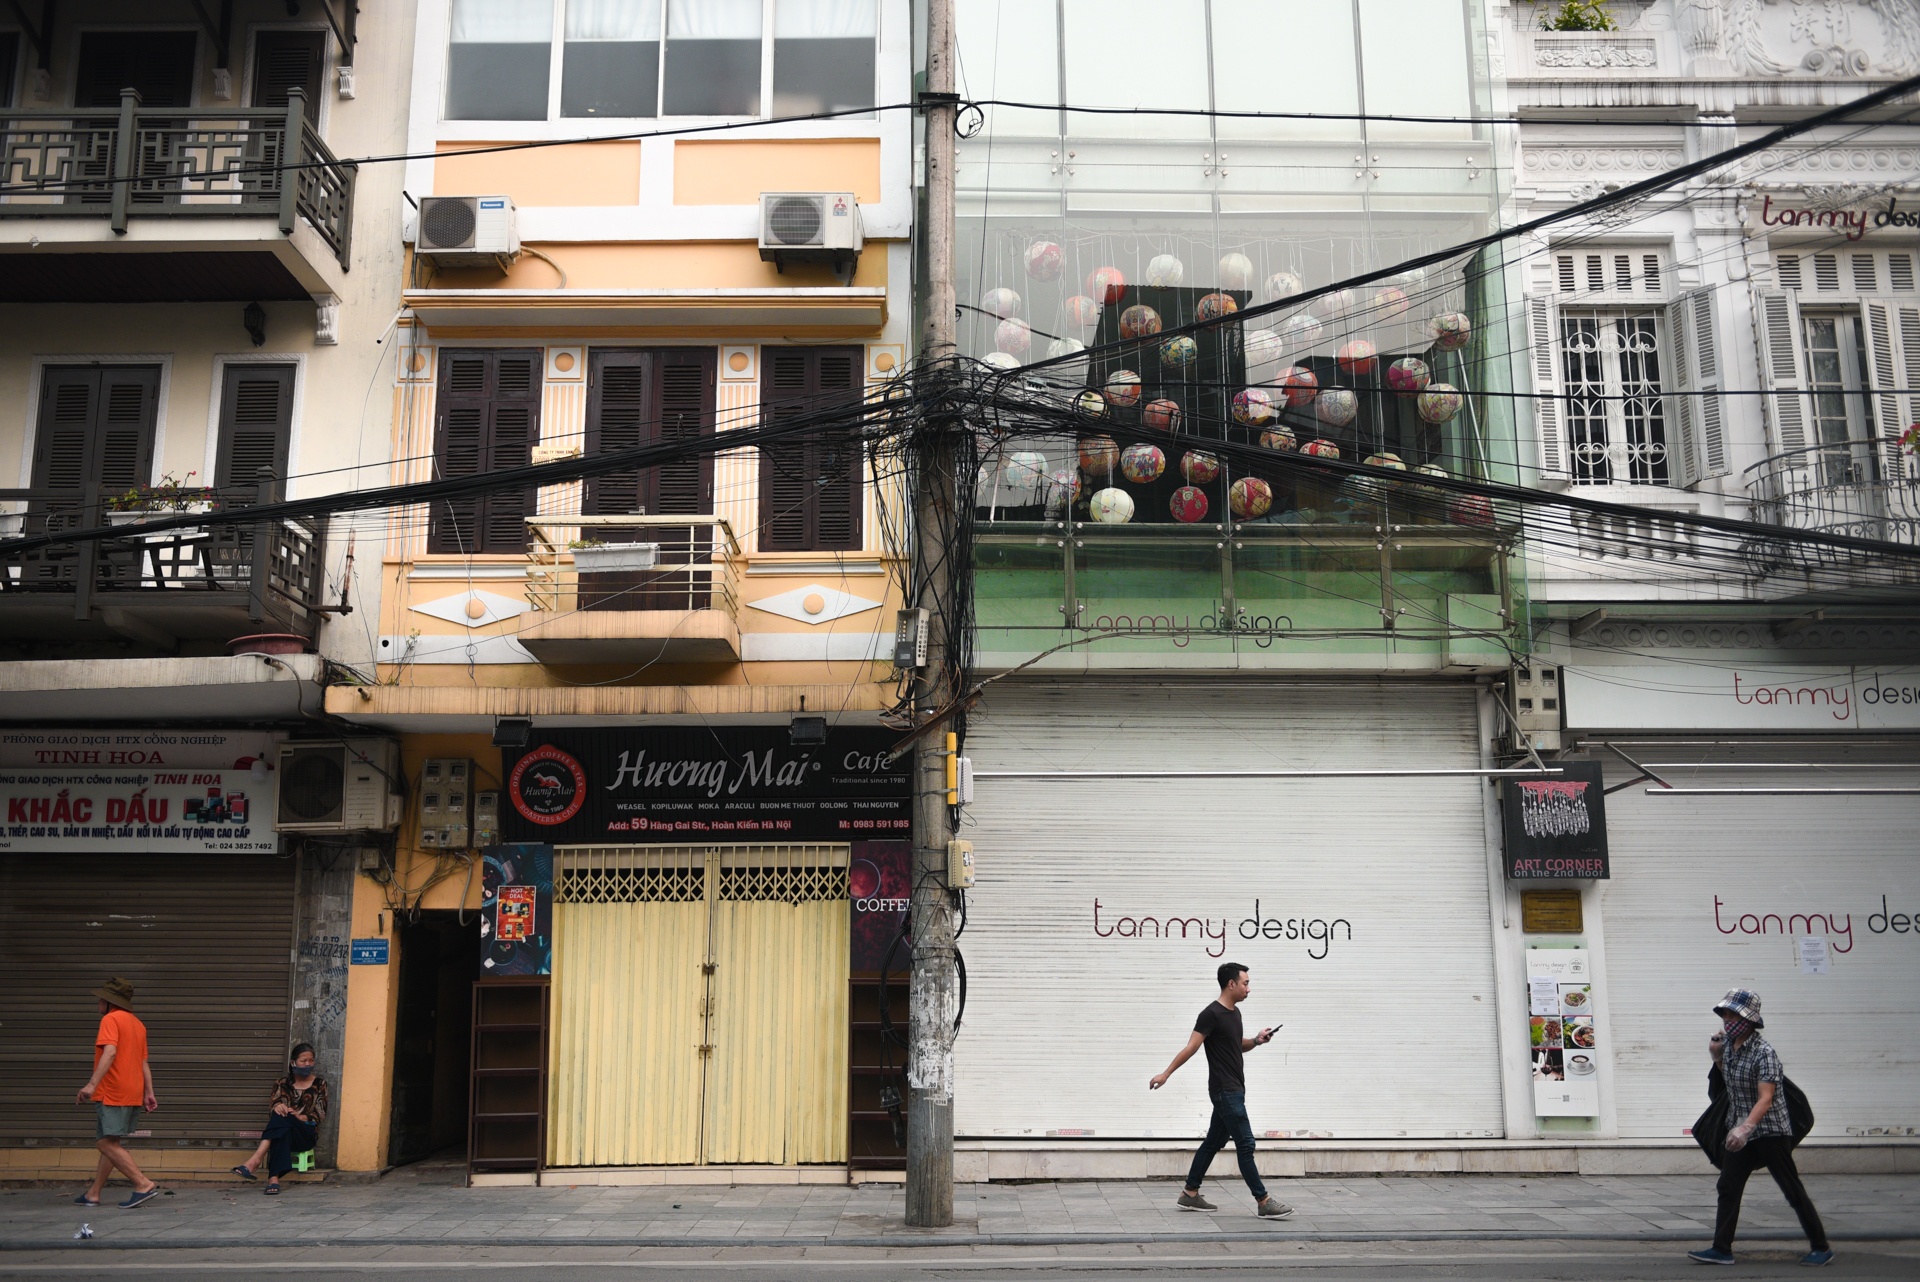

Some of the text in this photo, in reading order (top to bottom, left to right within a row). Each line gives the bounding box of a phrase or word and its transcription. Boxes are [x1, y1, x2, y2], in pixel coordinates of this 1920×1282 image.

[1762, 195, 1866, 241] tanmy
[1077, 599, 1189, 647] tanmy
[1734, 672, 1850, 720] tanmy
[4, 733, 44, 744] PHÒNG
[48, 736, 78, 744] GIAO
[82, 736, 110, 746] DỊCH
[116, 736, 141, 744] HTX
[180, 735, 226, 746] NGHIỆP
[35, 750, 165, 764] TINH HOA
[512, 754, 539, 787] ORIGINAL
[541, 752, 571, 764] COFFEE
[605, 748, 810, 798] Hương Mai
[18, 776, 40, 784] GIAO
[42, 776, 64, 786] DỊCH
[66, 776, 84, 784] HTX
[86, 774, 112, 784] CÔNG
[114, 774, 148, 786] NGHIỆP
[154, 774, 188, 784] TINH
[192, 774, 221, 784] HOA
[7, 788, 168, 824] KHẮC DẤU
[520, 804, 554, 822] ROASTERS
[533, 805, 550, 813] Since
[30, 827, 45, 837] CAO
[82, 827, 89, 837] IN
[117, 823, 133, 838] DẤU
[152, 826, 162, 838] VÀ
[164, 824, 180, 838] DẤU
[193, 826, 214, 840] ĐỘNG
[217, 828, 232, 838] CAO
[234, 824, 250, 838] CẤP
[608, 822, 629, 830] Add:
[631, 817, 648, 829] 59
[650, 820, 673, 831] Hàng
[675, 821, 690, 830] Gai
[712, 820, 735, 830] Hoàn
[737, 819, 759, 829] Kiếm
[761, 820, 774, 829] Hà
[776, 820, 792, 830] Nội
[839, 820, 850, 829] M:
[853, 820, 874, 829] 0983
[876, 820, 891, 828] 591
[893, 820, 909, 828] 985
[1514, 859, 1603, 871] ART CORNER
[1531, 868, 1550, 877] the
[1554, 868, 1573, 877] 2nd
[1578, 868, 1603, 877] floor
[1094, 898, 1351, 959] tanmy design
[1715, 895, 1852, 953] tanmy
